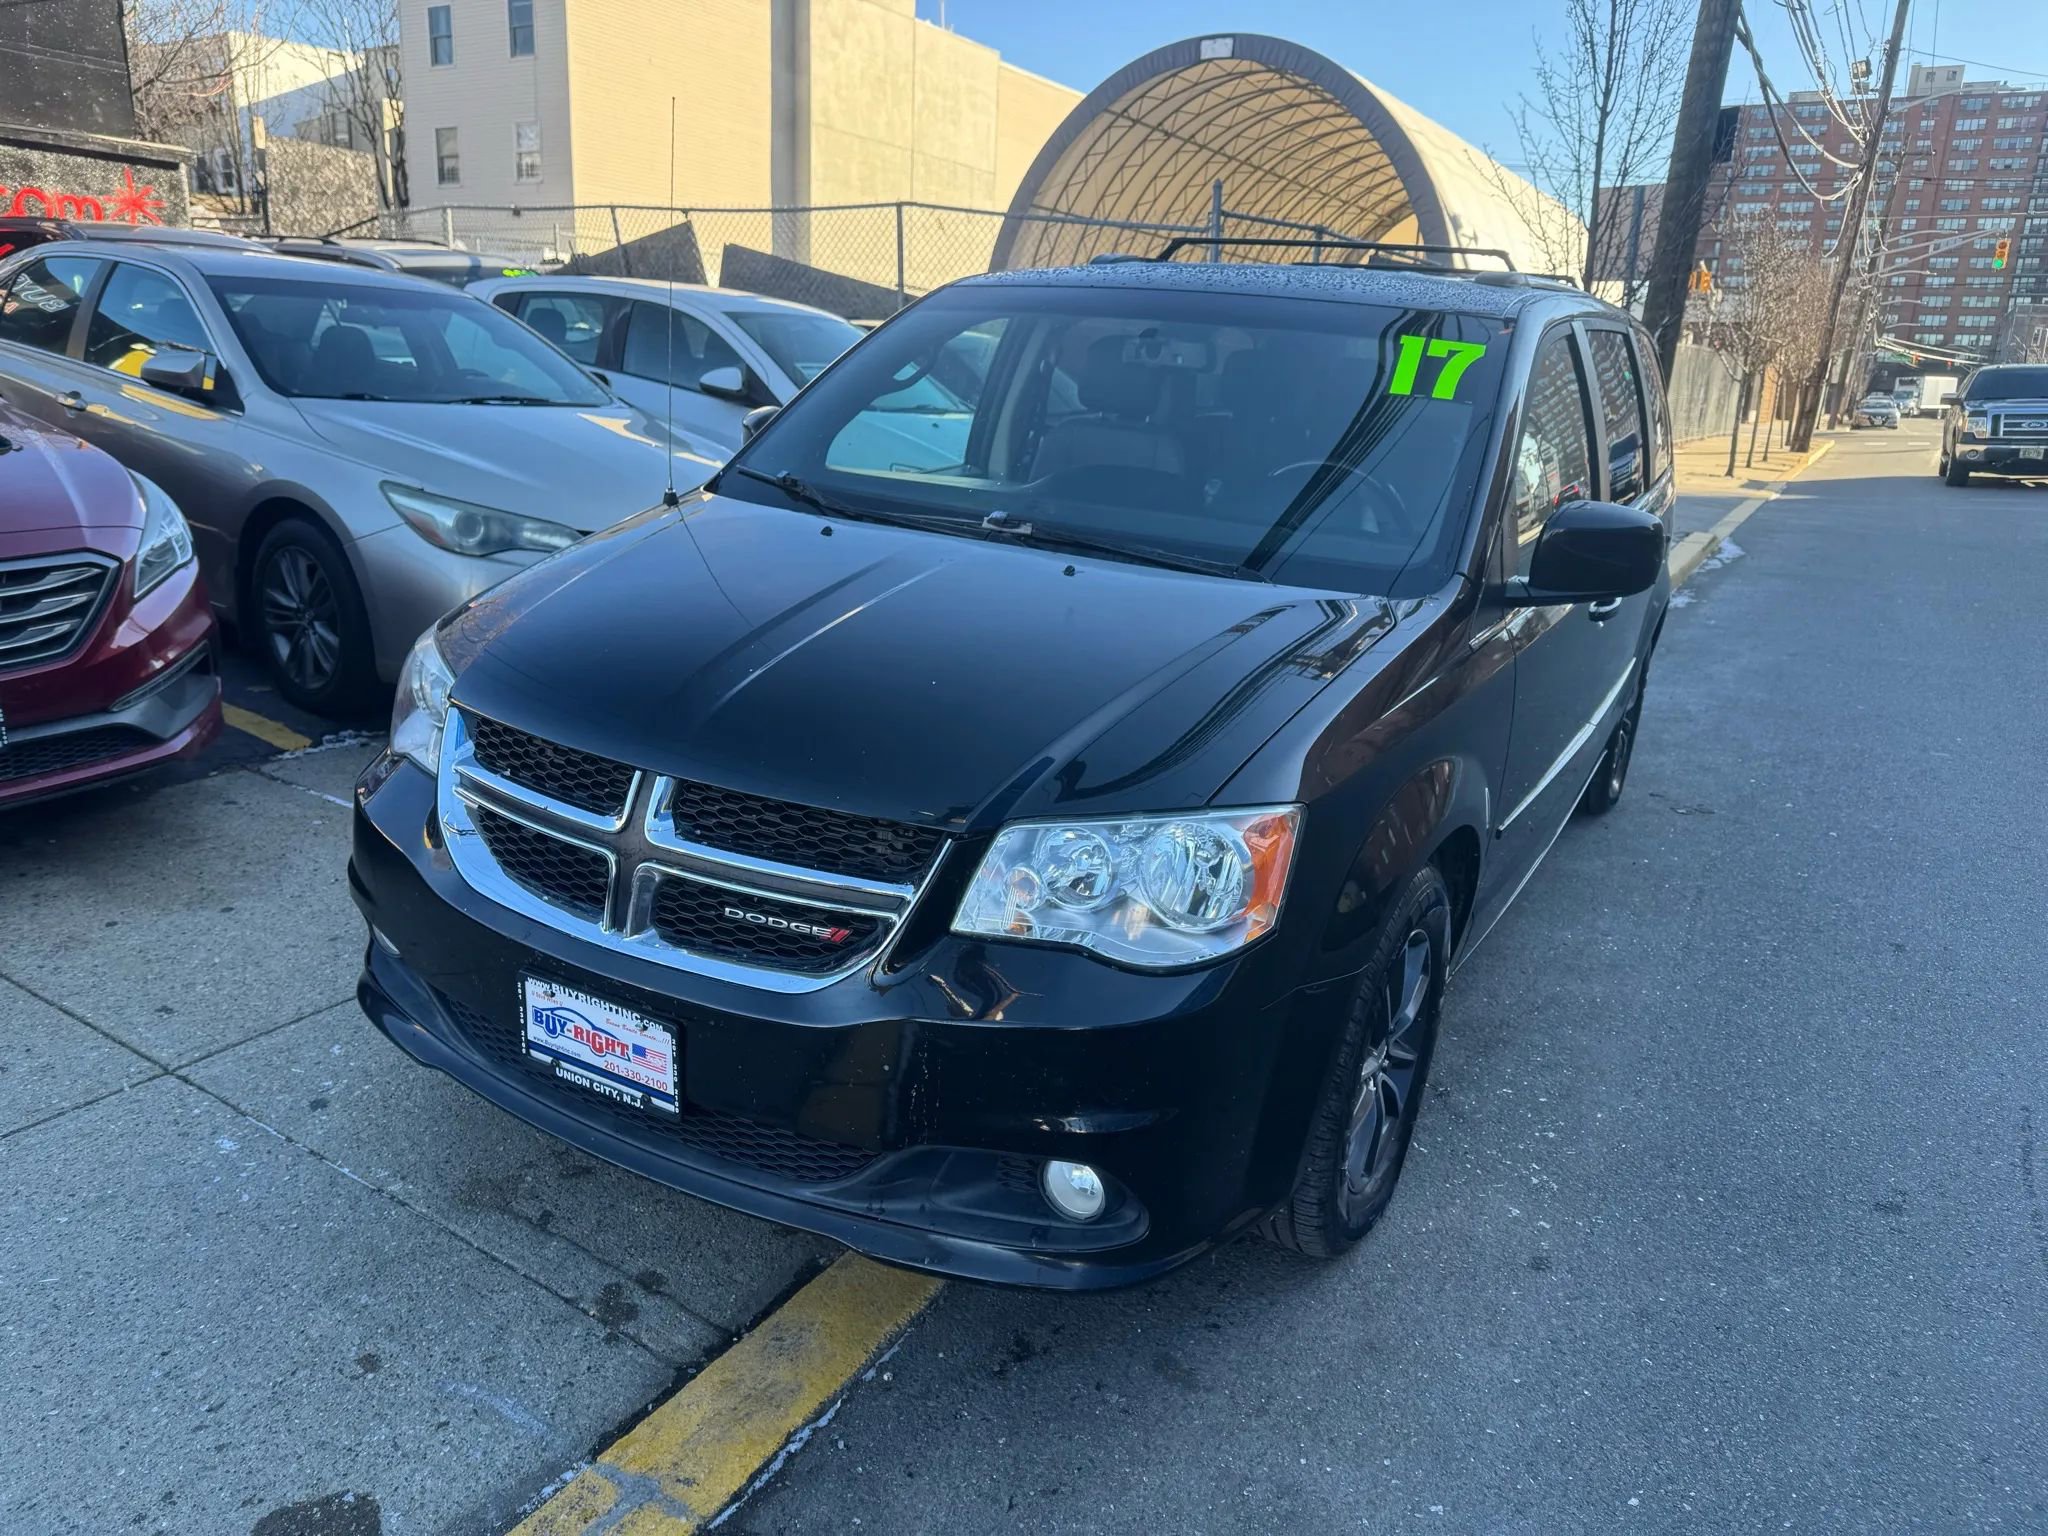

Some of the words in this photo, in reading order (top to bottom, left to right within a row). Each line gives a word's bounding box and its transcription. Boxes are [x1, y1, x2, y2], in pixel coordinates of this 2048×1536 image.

[1389, 334, 1487, 400] 17
[724, 907, 832, 938] DODGE
[555, 1067, 591, 1089] UNION
[592, 1083, 620, 1101] CITY,
[623, 1094, 644, 1109] N.J.
[604, 1060, 668, 1091] 201-330-2100
